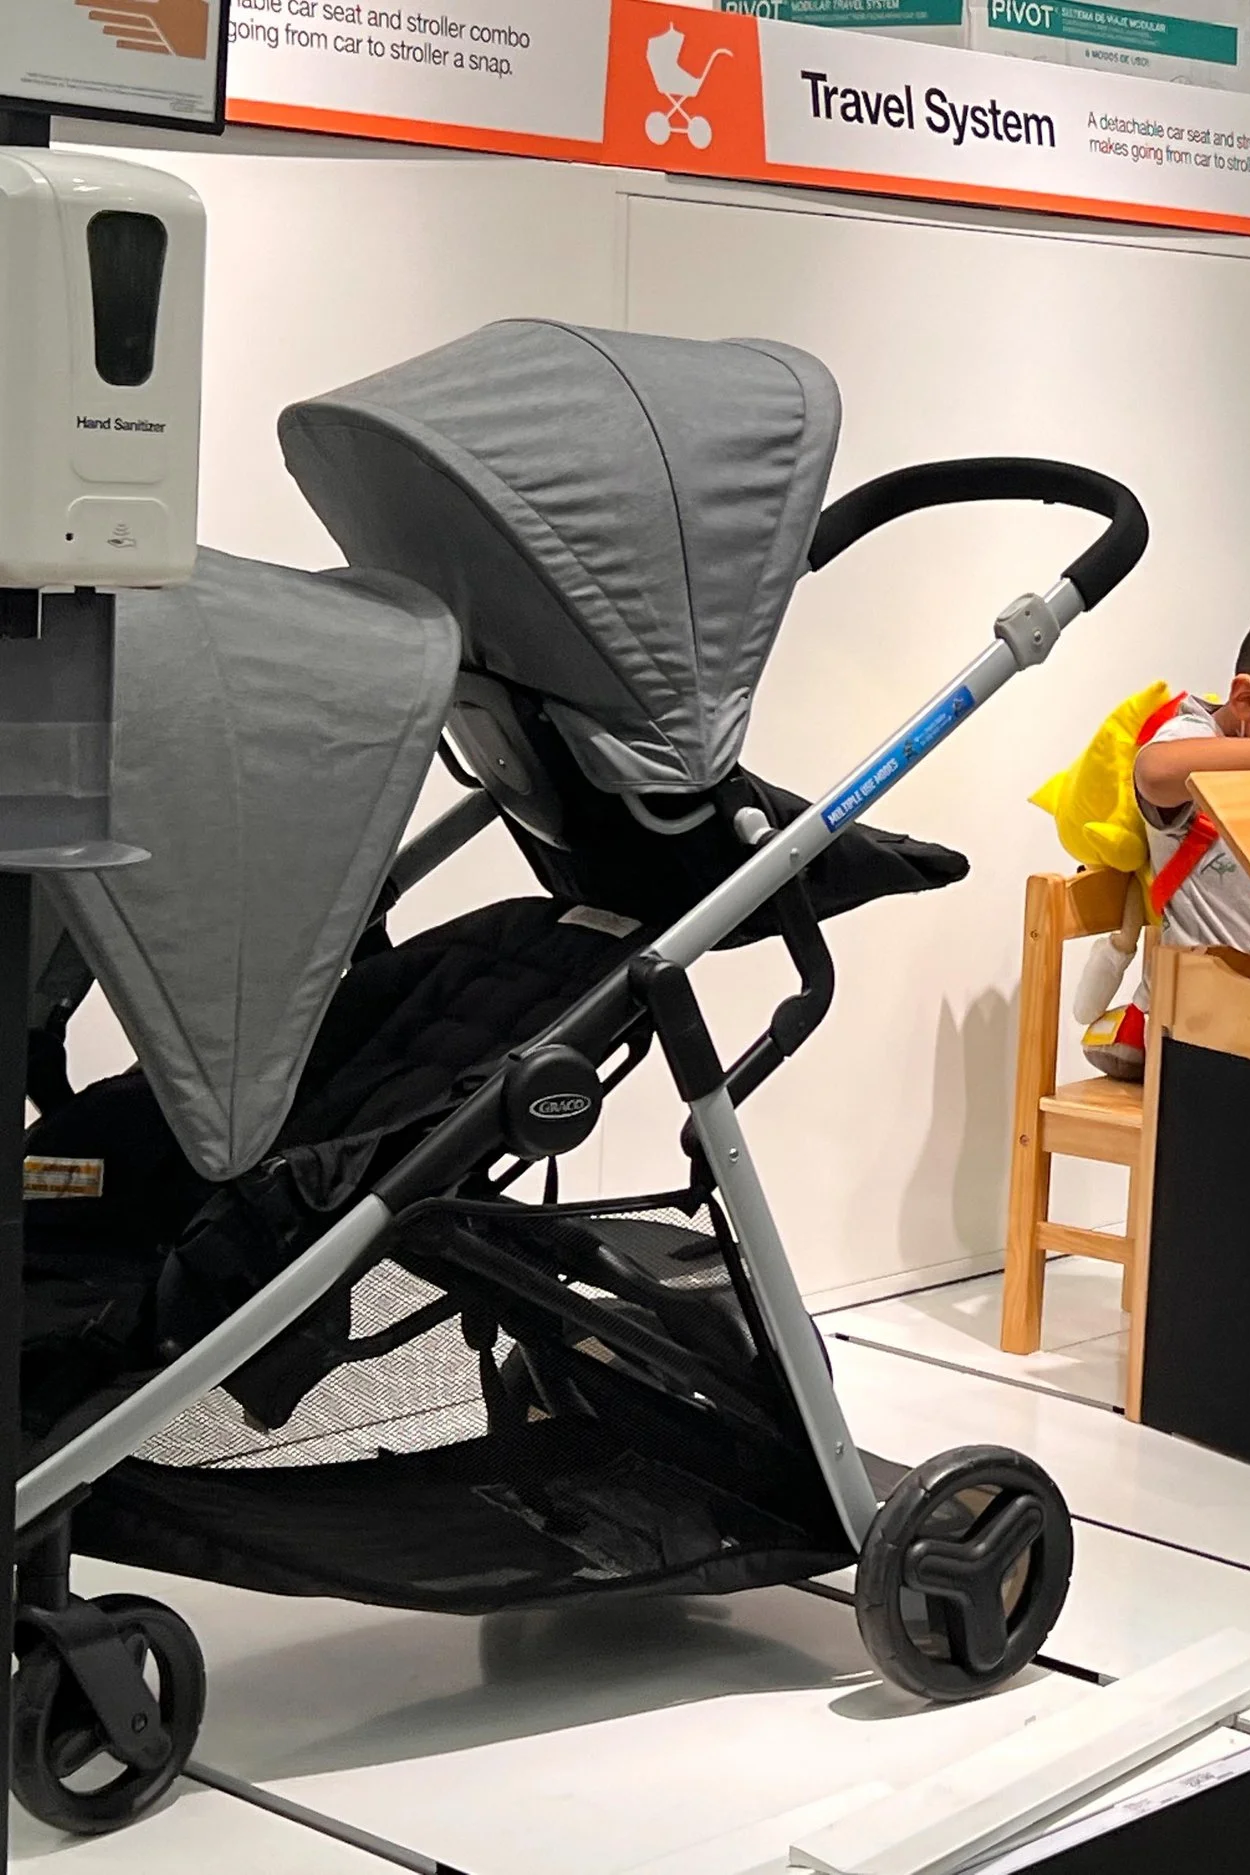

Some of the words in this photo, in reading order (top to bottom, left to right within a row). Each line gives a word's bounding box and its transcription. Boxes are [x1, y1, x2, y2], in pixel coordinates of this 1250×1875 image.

[867, 0, 900, 10] SYSTEM
[991, 0, 1054, 29] PIVOT
[287, 0, 318, 18] car
[322, 3, 362, 25] seat
[367, 9, 402, 30] and
[407, 13, 466, 39] stroller
[470, 23, 531, 49] combo
[228, 18, 279, 48] going
[285, 23, 328, 50] from
[333, 35, 362, 54] car
[368, 37, 386, 58] to
[390, 41, 450, 66] stroller
[453, 51, 465, 69] a
[468, 53, 514, 79] snap.
[800, 69, 915, 130] Travel
[924, 87, 1056, 147] System
[1087, 110, 1098, 129] A
[1100, 113, 1165, 139] detachable
[1166, 124, 1185, 141] car
[1187, 127, 1211, 145] seat
[1213, 131, 1235, 149] and
[1089, 137, 1129, 157] makes
[1131, 143, 1164, 166] going
[1165, 144, 1192, 165] from
[1194, 152, 1212, 168] car
[1214, 153, 1226, 170] to
[76, 416, 111, 430] Hand
[114, 418, 167, 433] Sanitizer
[538, 1098, 586, 1114] GRACO
